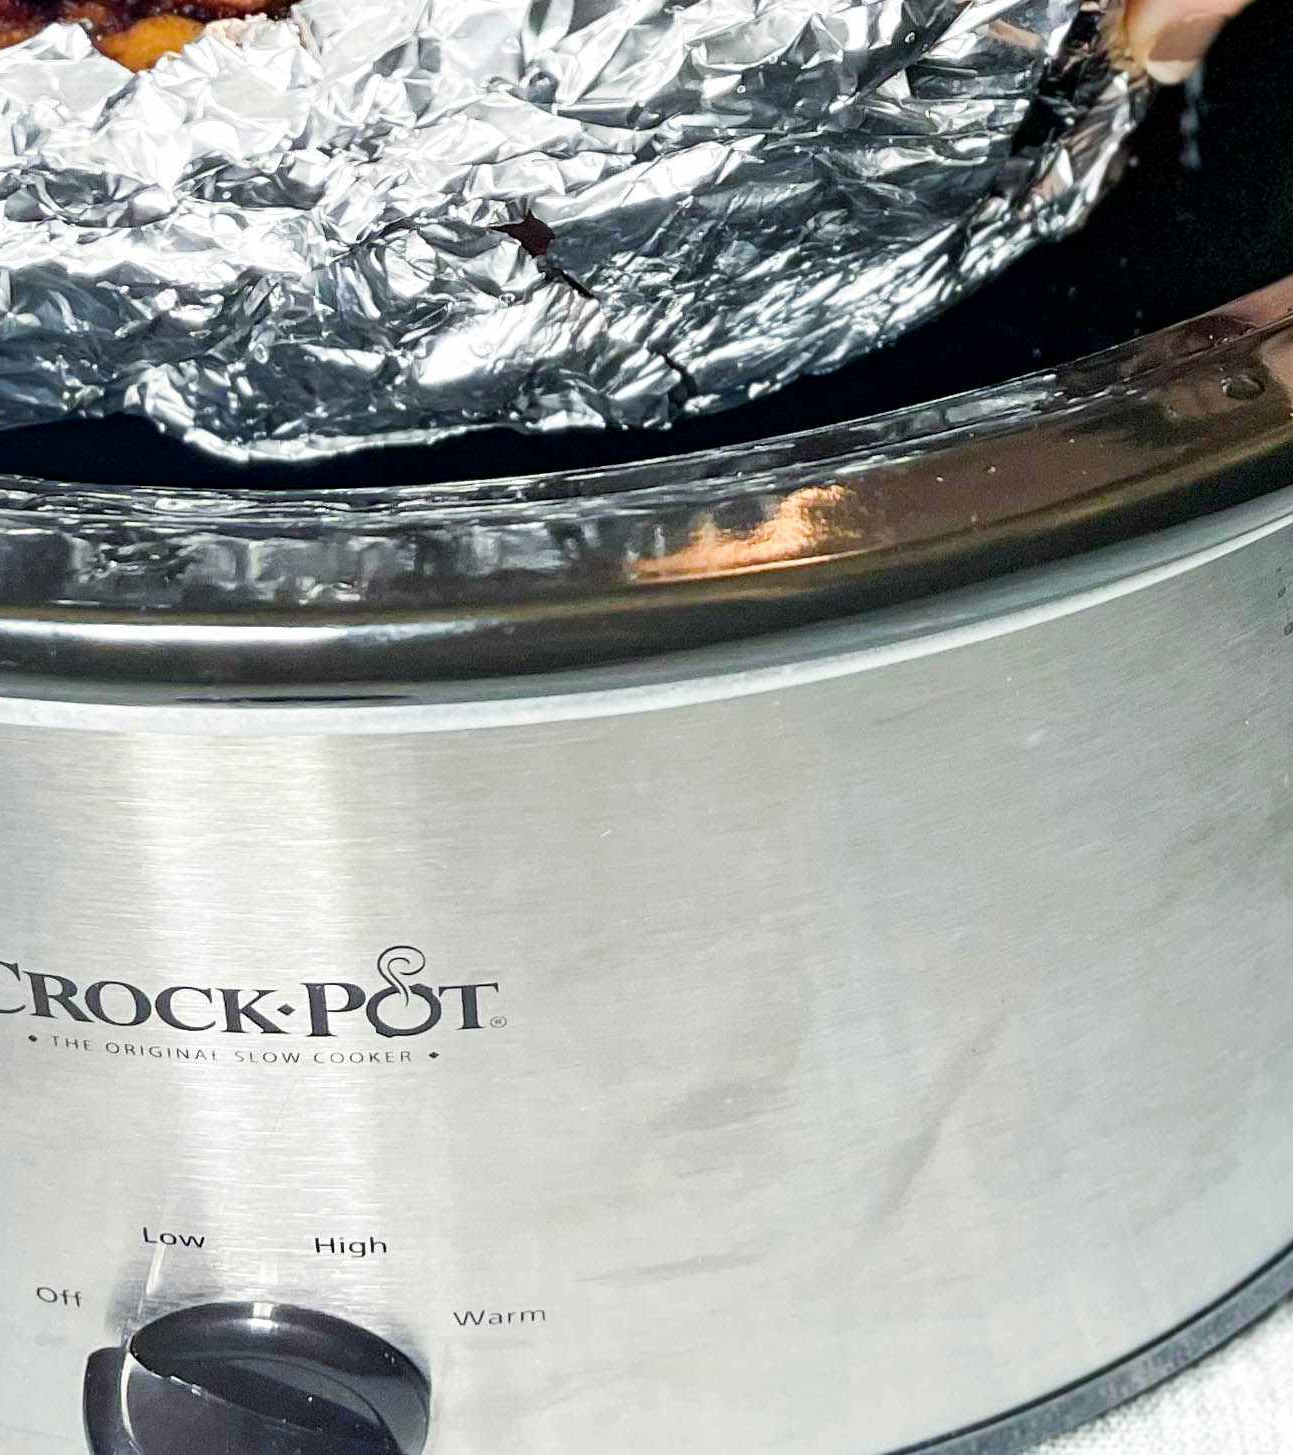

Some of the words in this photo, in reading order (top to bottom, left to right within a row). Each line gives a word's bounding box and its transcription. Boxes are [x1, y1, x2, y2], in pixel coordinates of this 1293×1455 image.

[51, 1035, 92, 1052] THE
[105, 1040, 219, 1062] ORIGINAL
[234, 1050, 299, 1064] SLOW
[313, 1050, 412, 1065] COOKER
[142, 1226, 206, 1248] Low
[314, 1236, 388, 1258] High
[35, 1285, 83, 1308] Off
[452, 1305, 547, 1327] Warm
